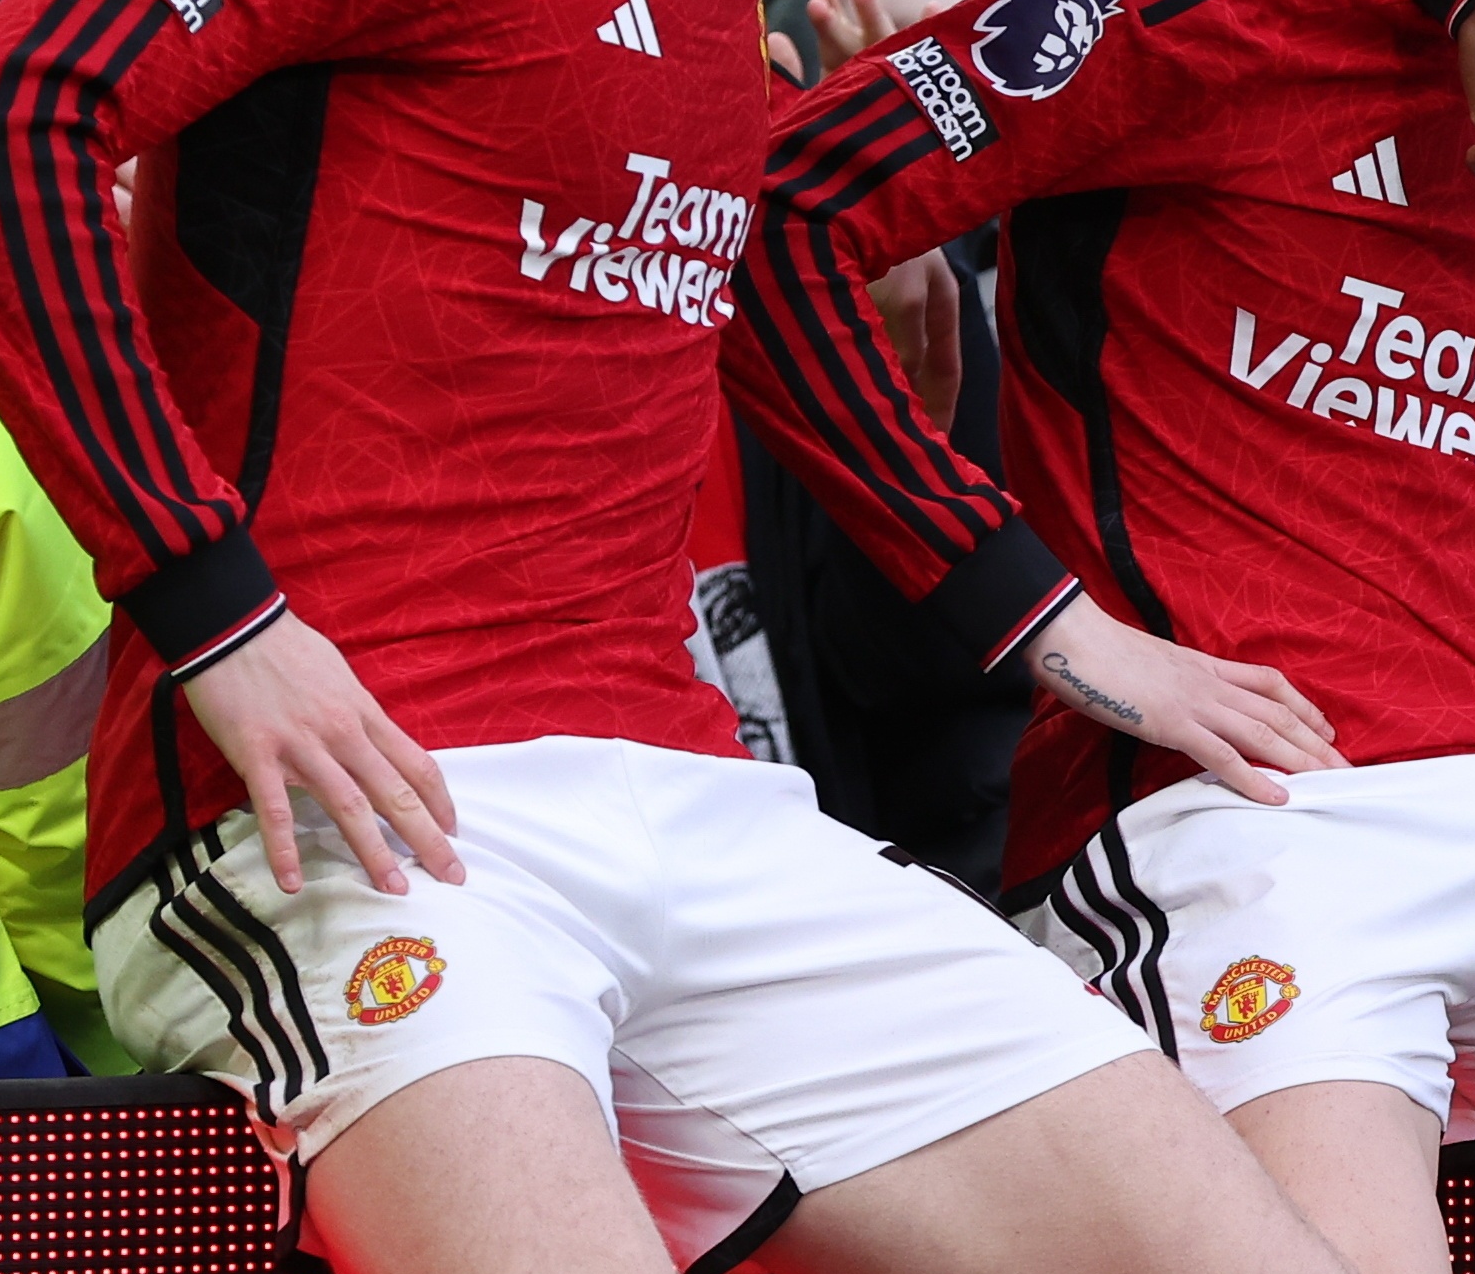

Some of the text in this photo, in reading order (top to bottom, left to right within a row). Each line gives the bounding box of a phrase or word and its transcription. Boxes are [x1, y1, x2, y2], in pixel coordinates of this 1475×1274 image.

[885, 48, 972, 162] for racism
[910, 36, 986, 138] No room
[617, 152, 746, 261] Team
[520, 198, 724, 327] Viewer
[1042, 652, 1144, 725] Concepción
[350, 941, 428, 993] MANCHESTER
[1209, 962, 1286, 1006] MANCHESTER
[374, 987, 431, 1021] UNITED
[1224, 1011, 1277, 1039] UNITED
